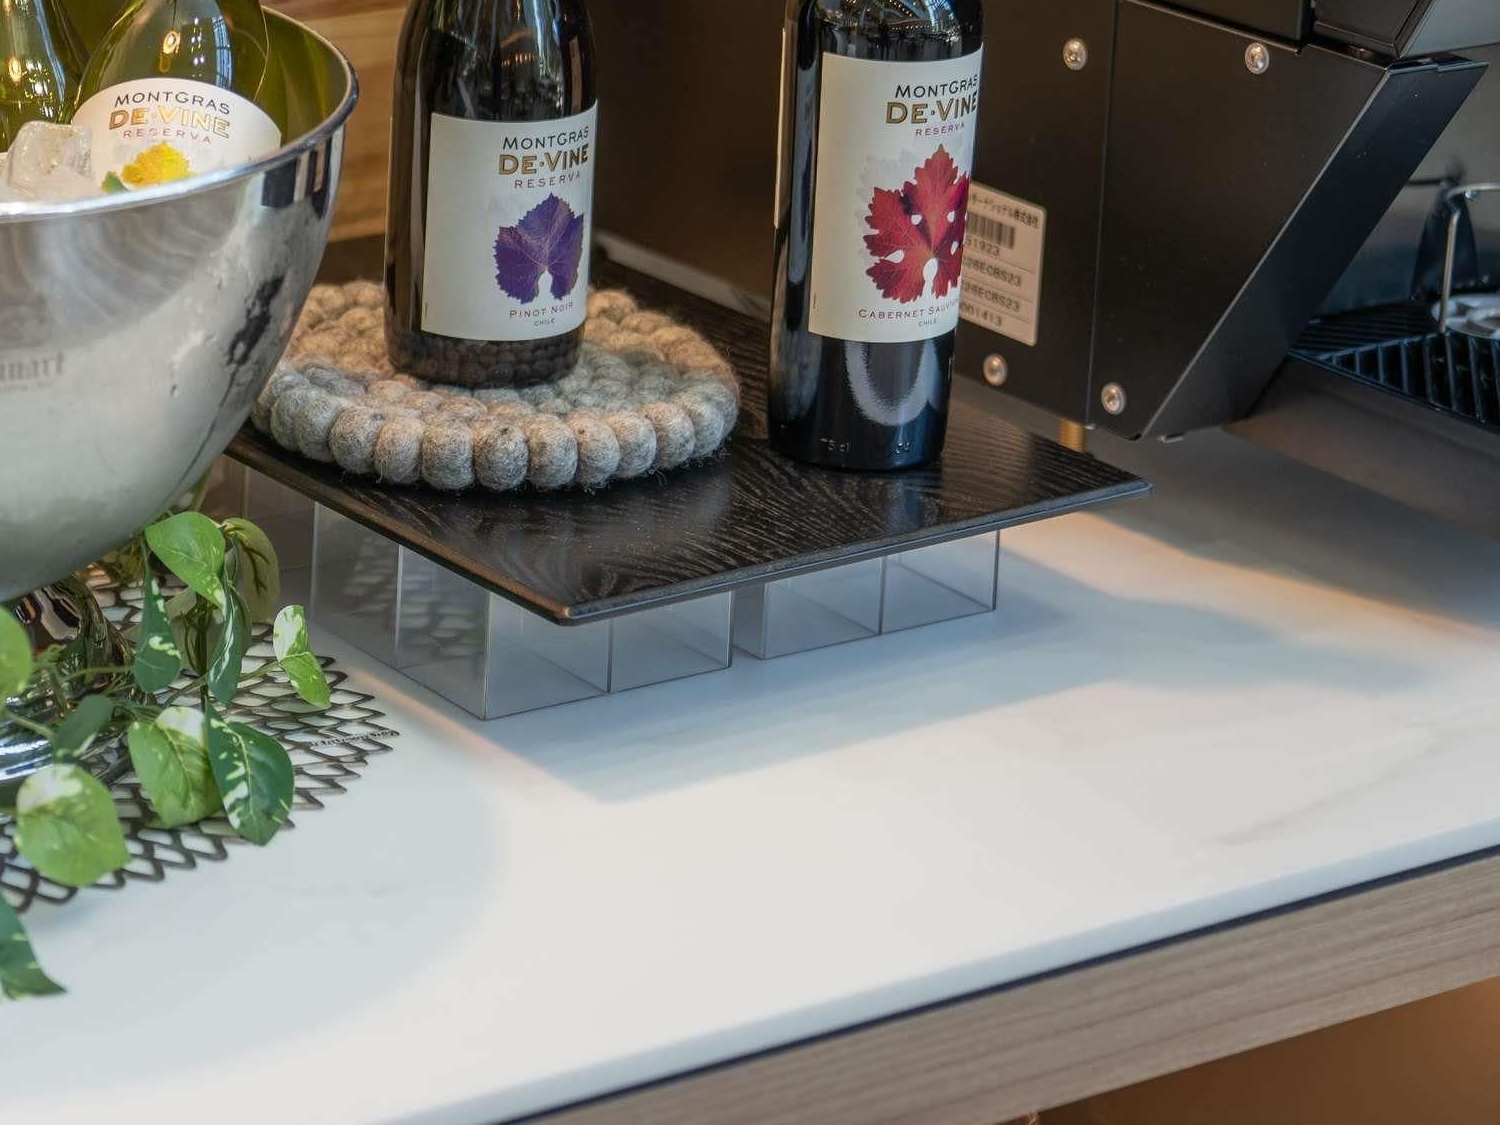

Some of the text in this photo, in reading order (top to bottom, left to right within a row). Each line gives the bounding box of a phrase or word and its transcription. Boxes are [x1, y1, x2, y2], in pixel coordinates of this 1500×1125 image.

[895, 74, 978, 98] MONTGRAS
[114, 91, 230, 115] MONTGRAS
[122, 128, 212, 144] RESERVA
[915, 122, 965, 136] RESERVA
[502, 126, 590, 150] MONTGRAS
[514, 172, 580, 189] RESERVA
[509, 302, 573, 318] PINOT NOIR
[858, 308, 925, 320] CABERNET
[534, 318, 556, 326] CHILE
